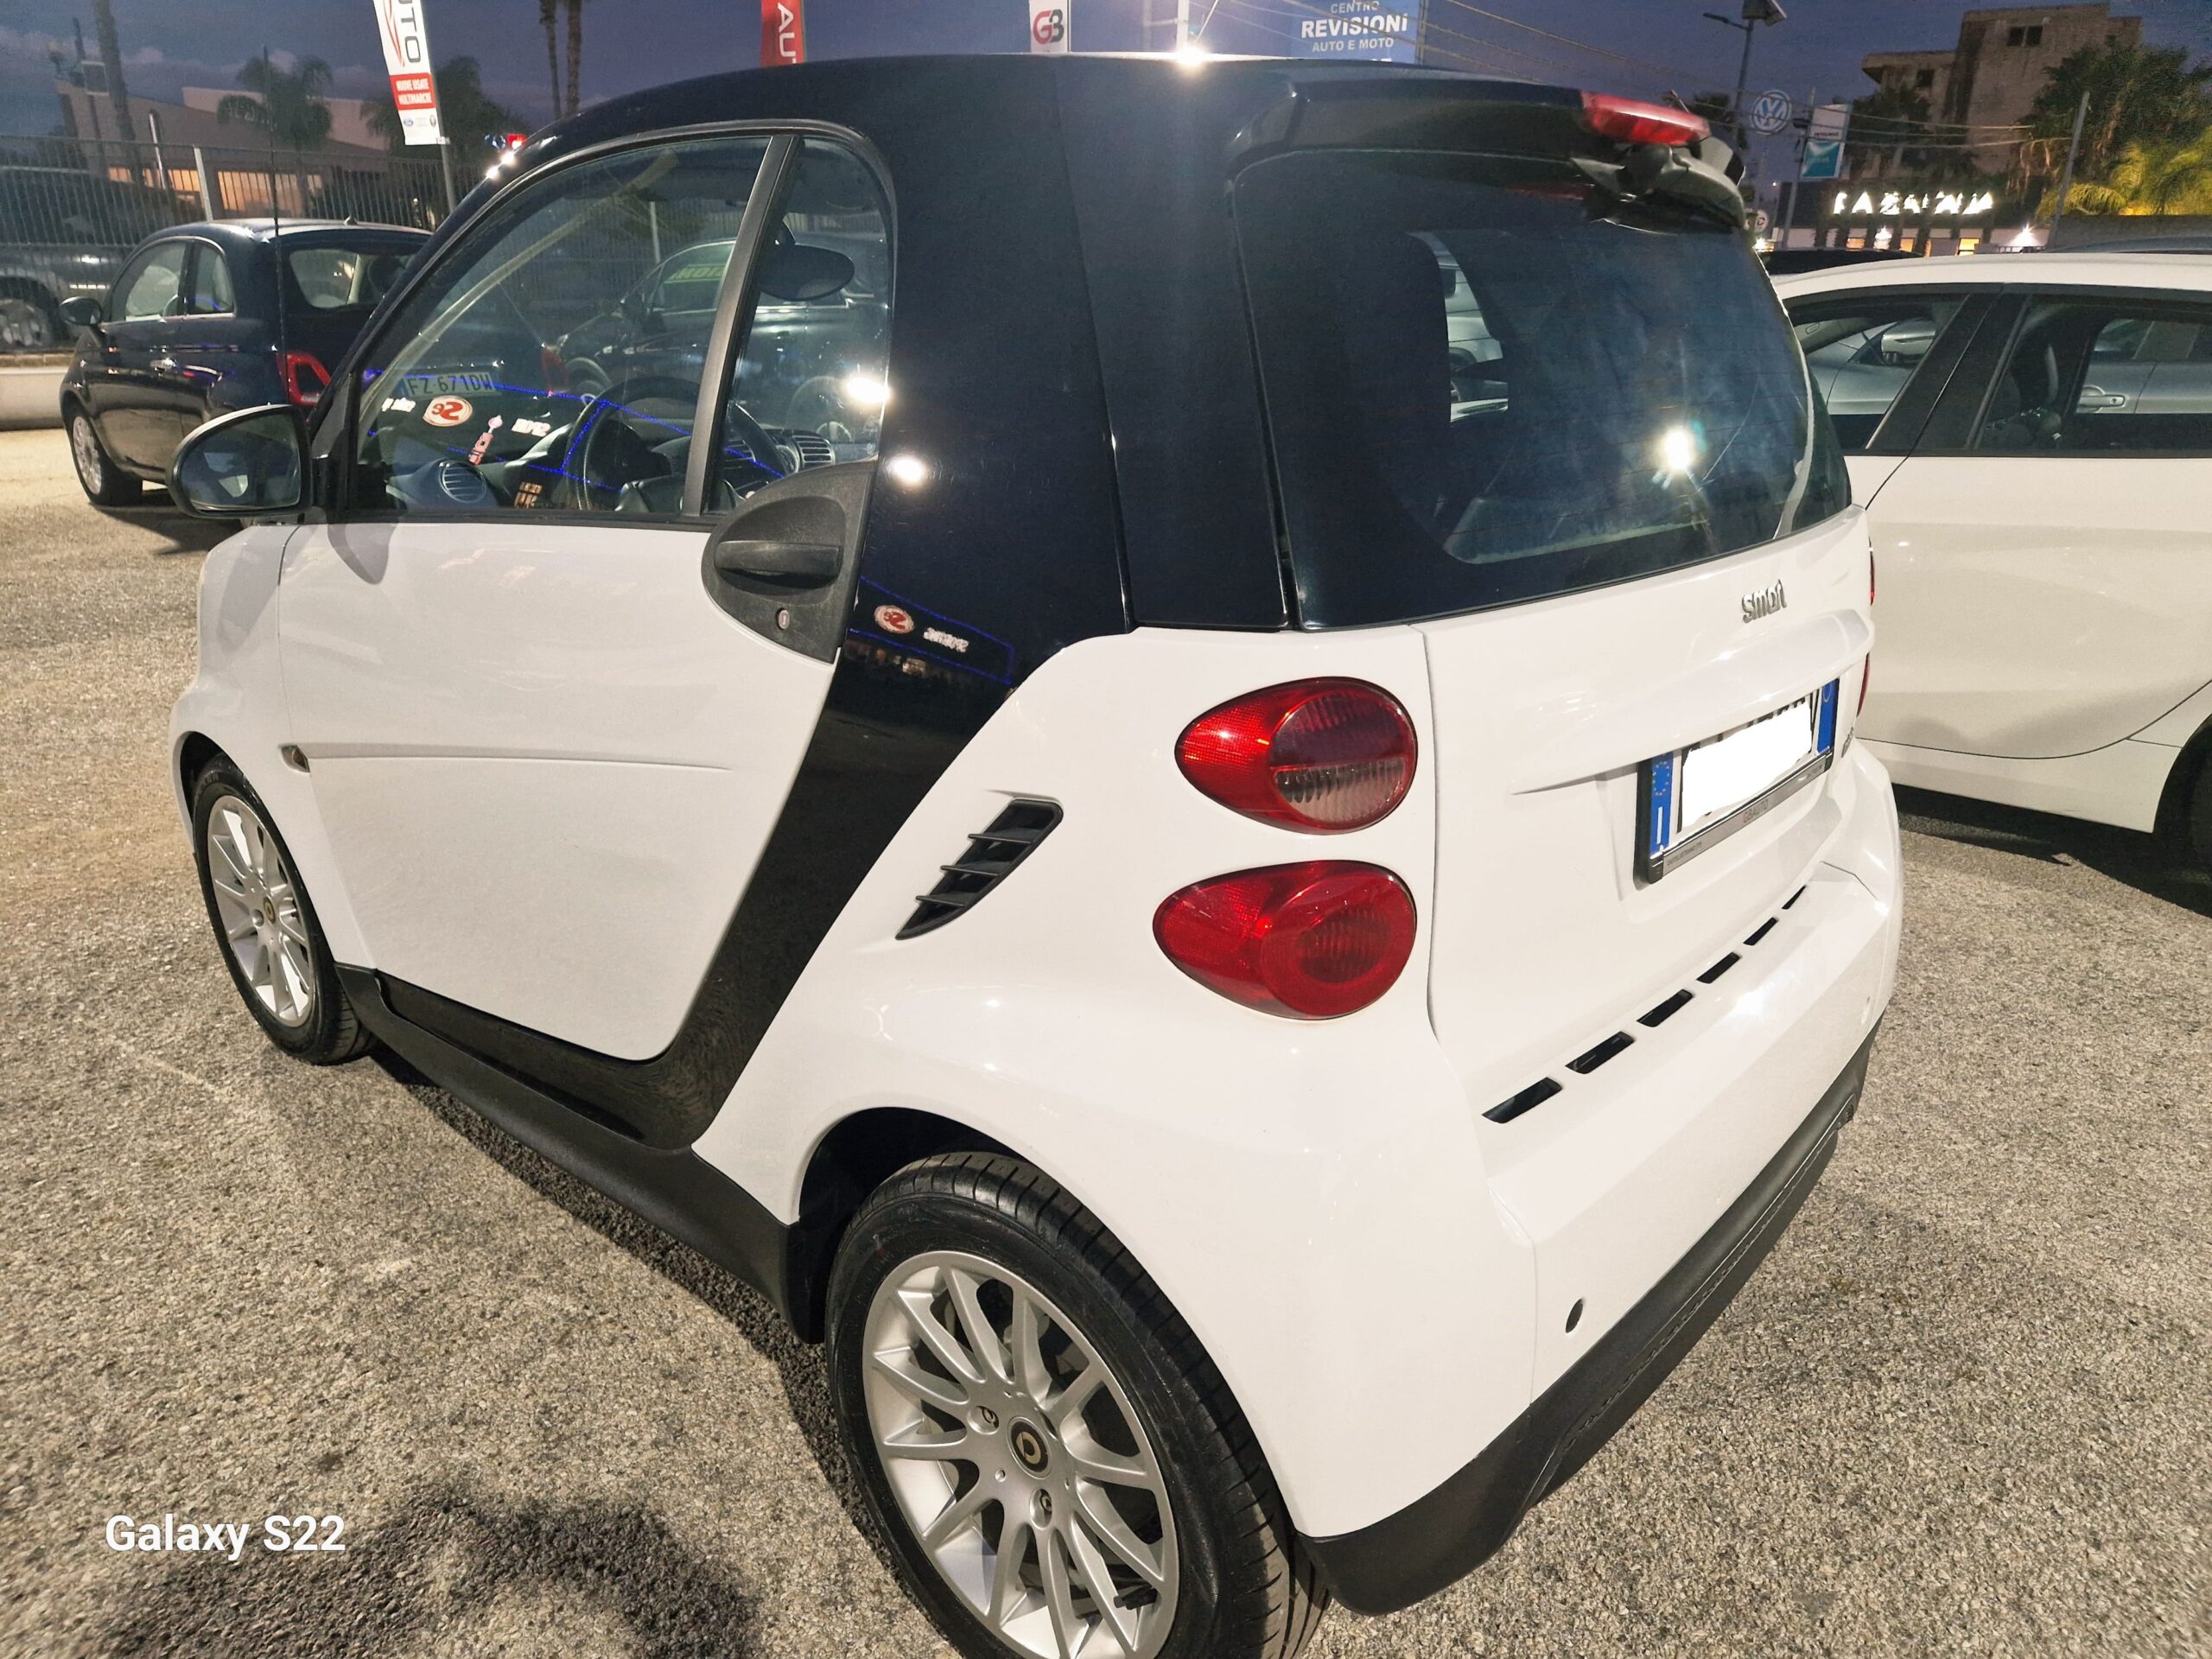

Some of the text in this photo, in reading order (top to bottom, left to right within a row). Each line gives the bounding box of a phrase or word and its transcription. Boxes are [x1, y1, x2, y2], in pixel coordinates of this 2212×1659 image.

[1331, 0, 1381, 14] CENTRO
[398, 0, 421, 63] TO
[778, 2, 797, 64] AU
[1301, 13, 1408, 39] REVISIONI
[1312, 37, 1395, 53] AUTO E MOTO
